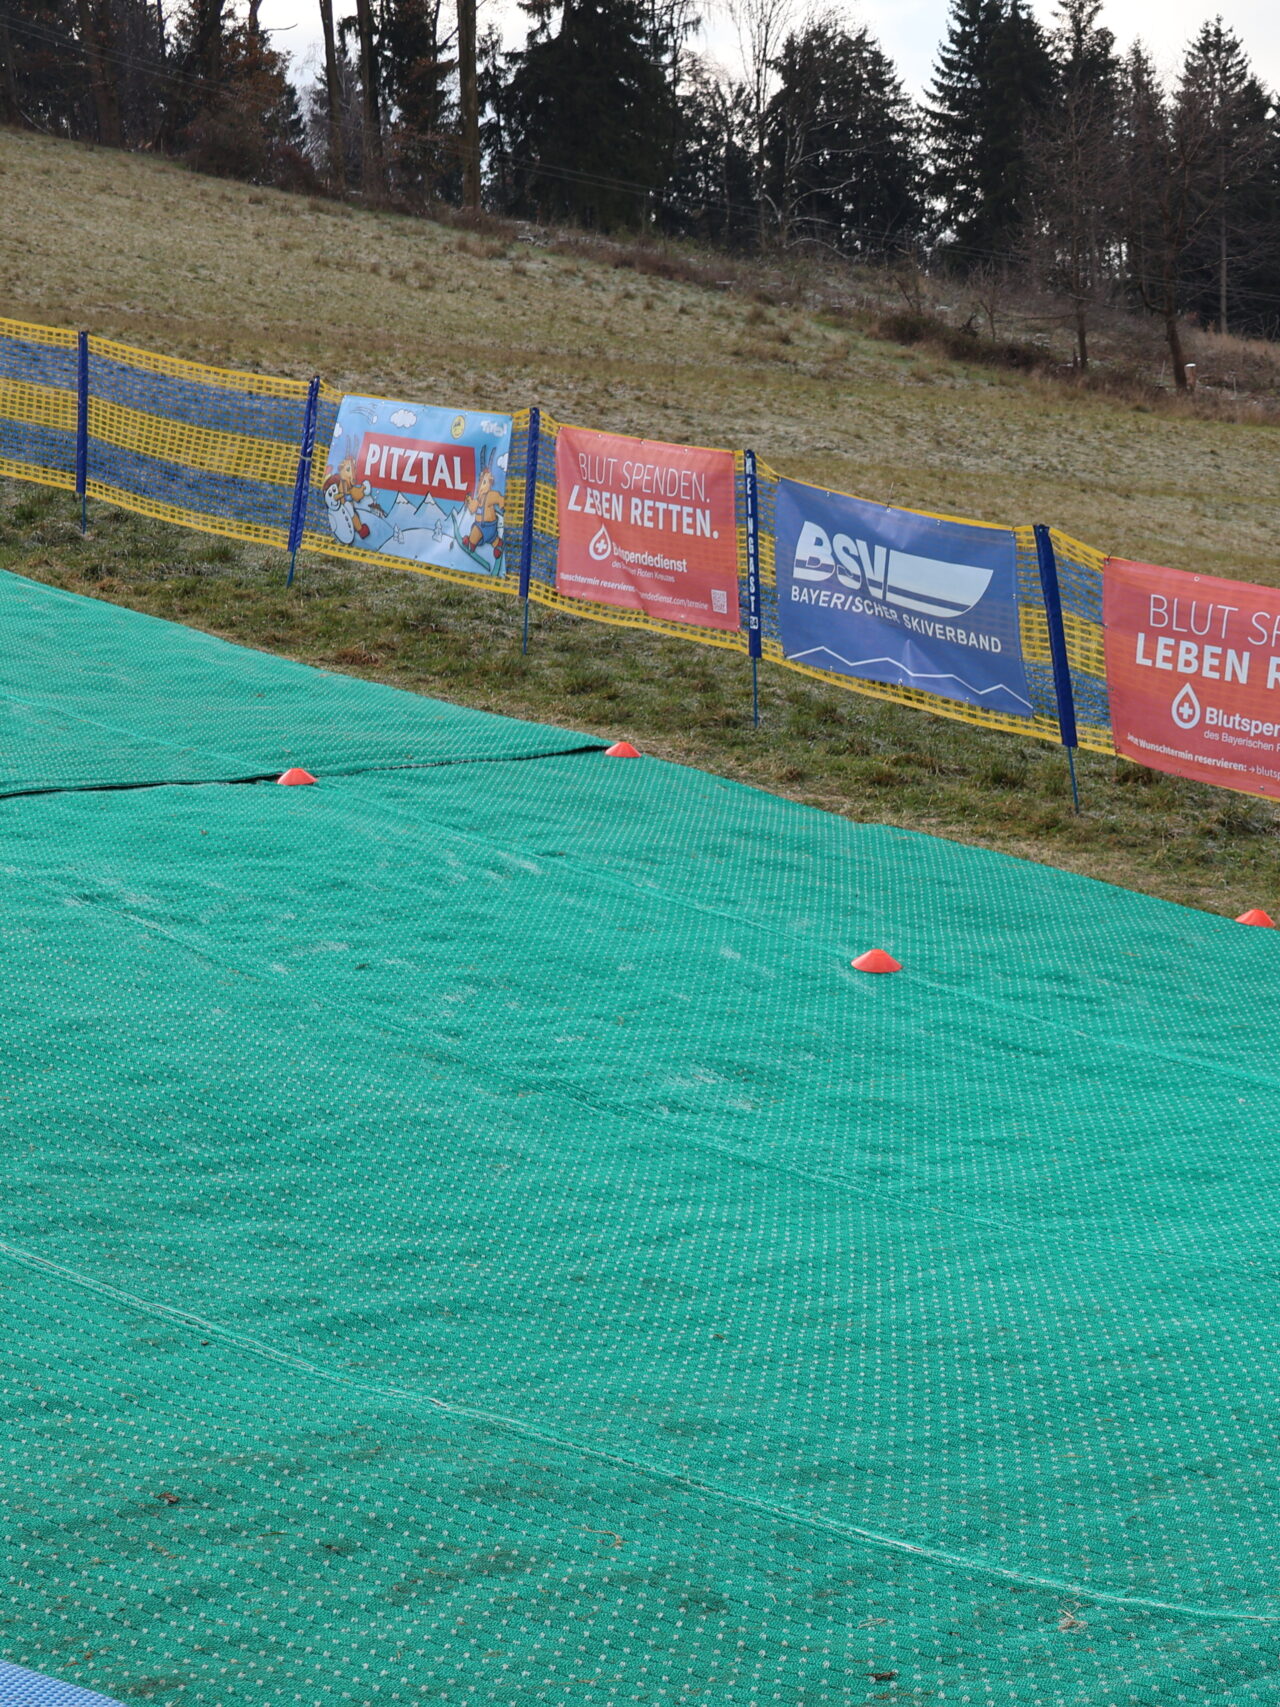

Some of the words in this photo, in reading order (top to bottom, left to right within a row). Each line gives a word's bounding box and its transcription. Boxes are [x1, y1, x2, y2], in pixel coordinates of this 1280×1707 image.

[364, 443, 469, 491] PITZTAL
[579, 452, 618, 486] BLUT
[620, 460, 711, 503] SPENDEN.
[567, 484, 624, 522] LEBEN
[630, 497, 720, 540] RETTEN.
[793, 520, 888, 600] BSV
[791, 585, 900, 624] BAYERISCHER
[902, 613, 1002, 653] SKIVERBAND
[1150, 594, 1239, 639] BLUT
[1135, 632, 1250, 685] LEBEN
[1139, 739, 1194, 761] Wunschtermin
[1194, 755, 1247, 772] reservieren:
[1204, 730, 1220, 741] des
[1221, 732, 1274, 751] Bayerischen
